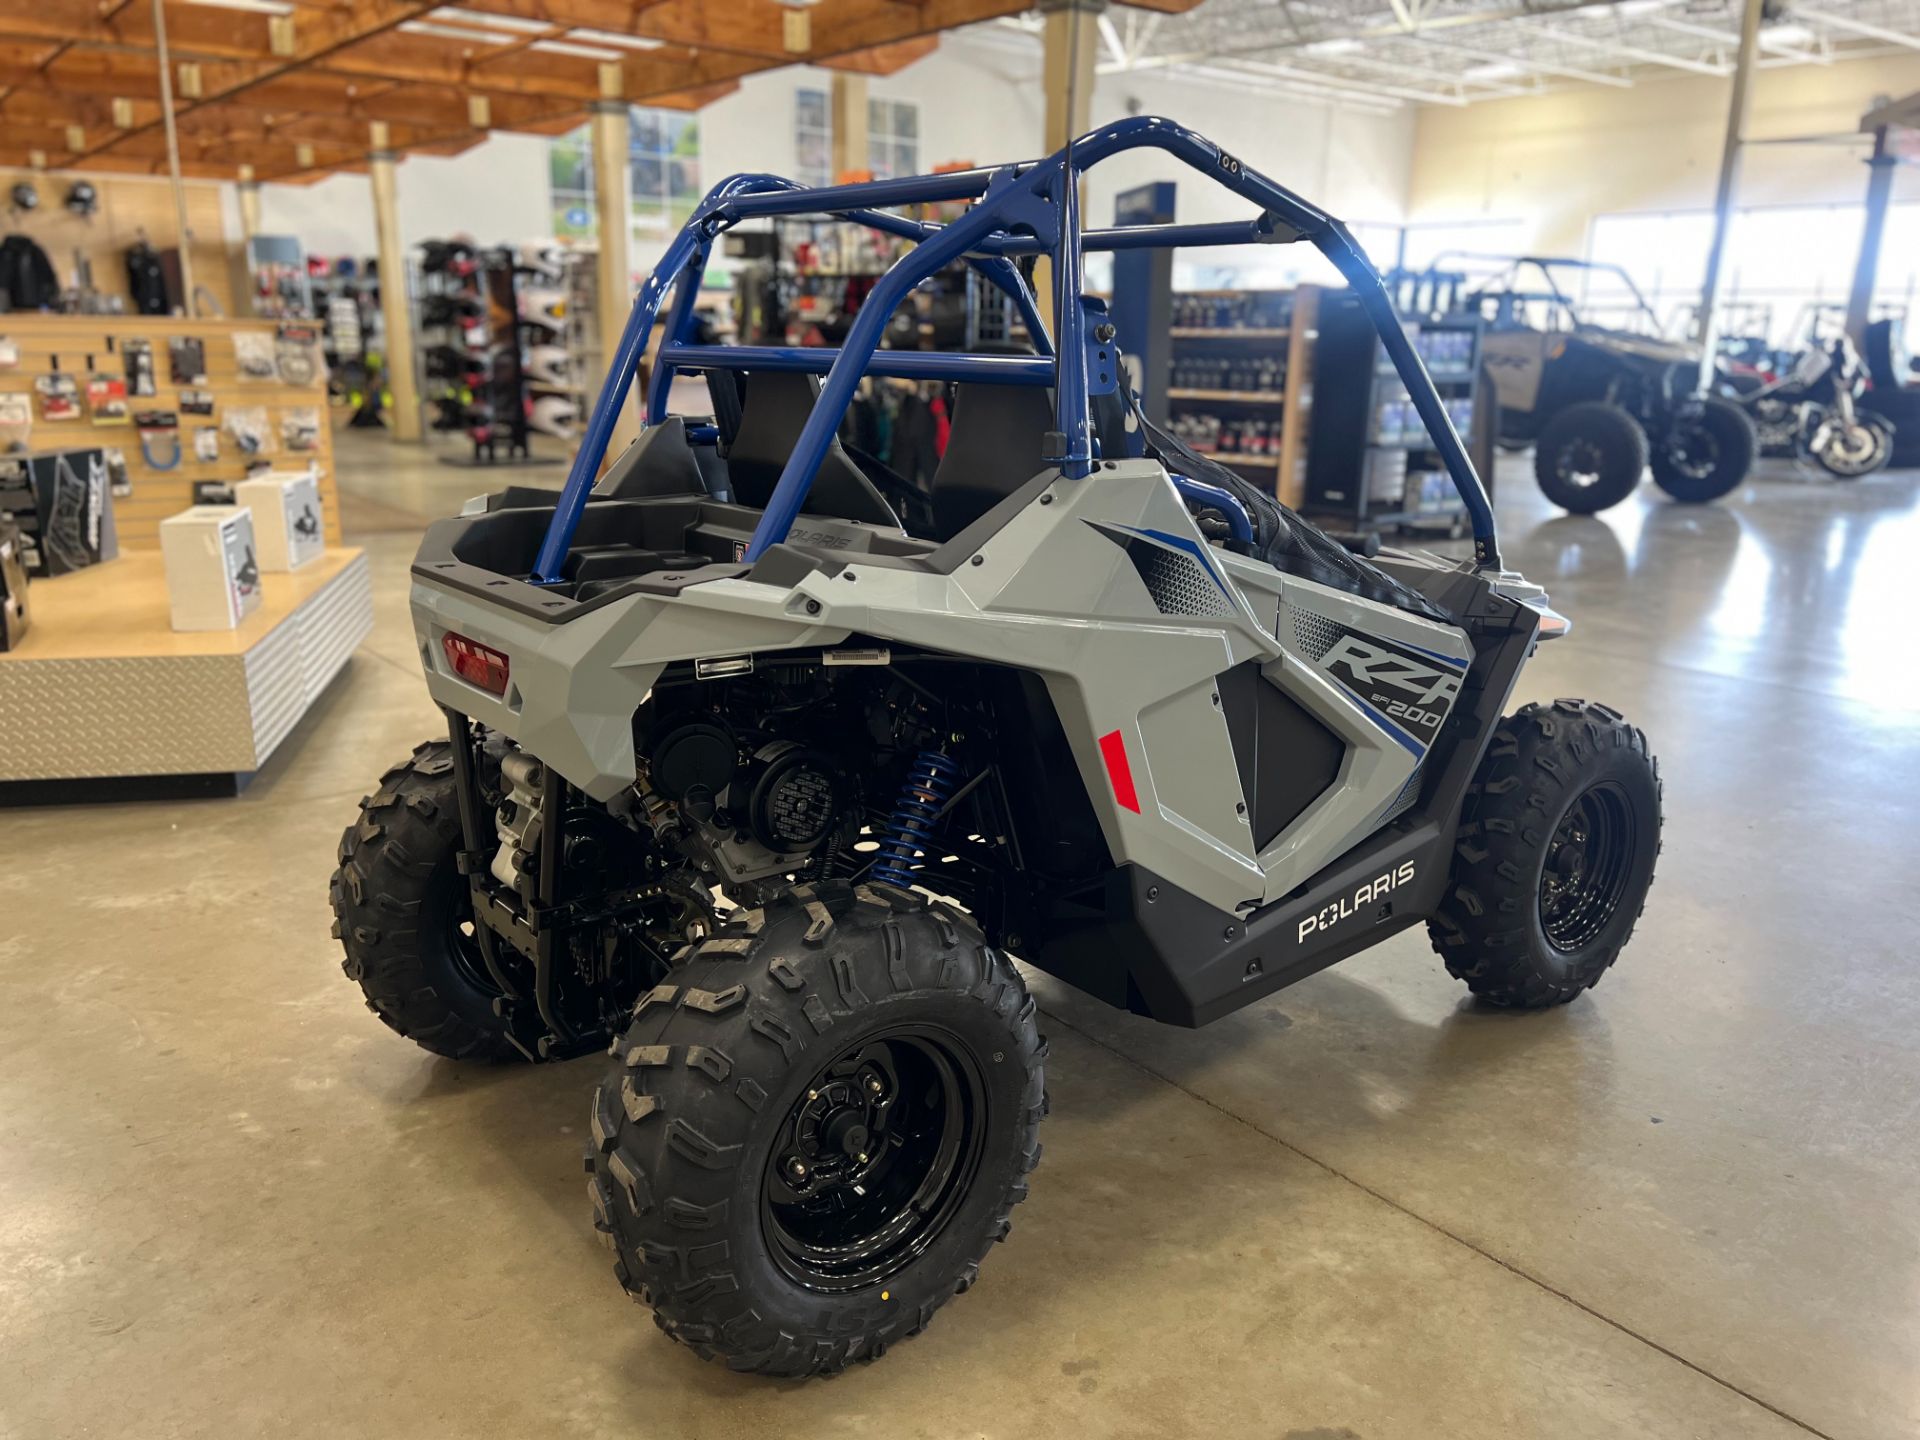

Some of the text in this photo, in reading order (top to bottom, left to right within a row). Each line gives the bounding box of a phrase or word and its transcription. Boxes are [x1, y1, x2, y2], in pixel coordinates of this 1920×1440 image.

[787, 528, 852, 549] OLARIS
[1386, 700, 1442, 728] 200
[1298, 859, 1415, 944] POLARIS
